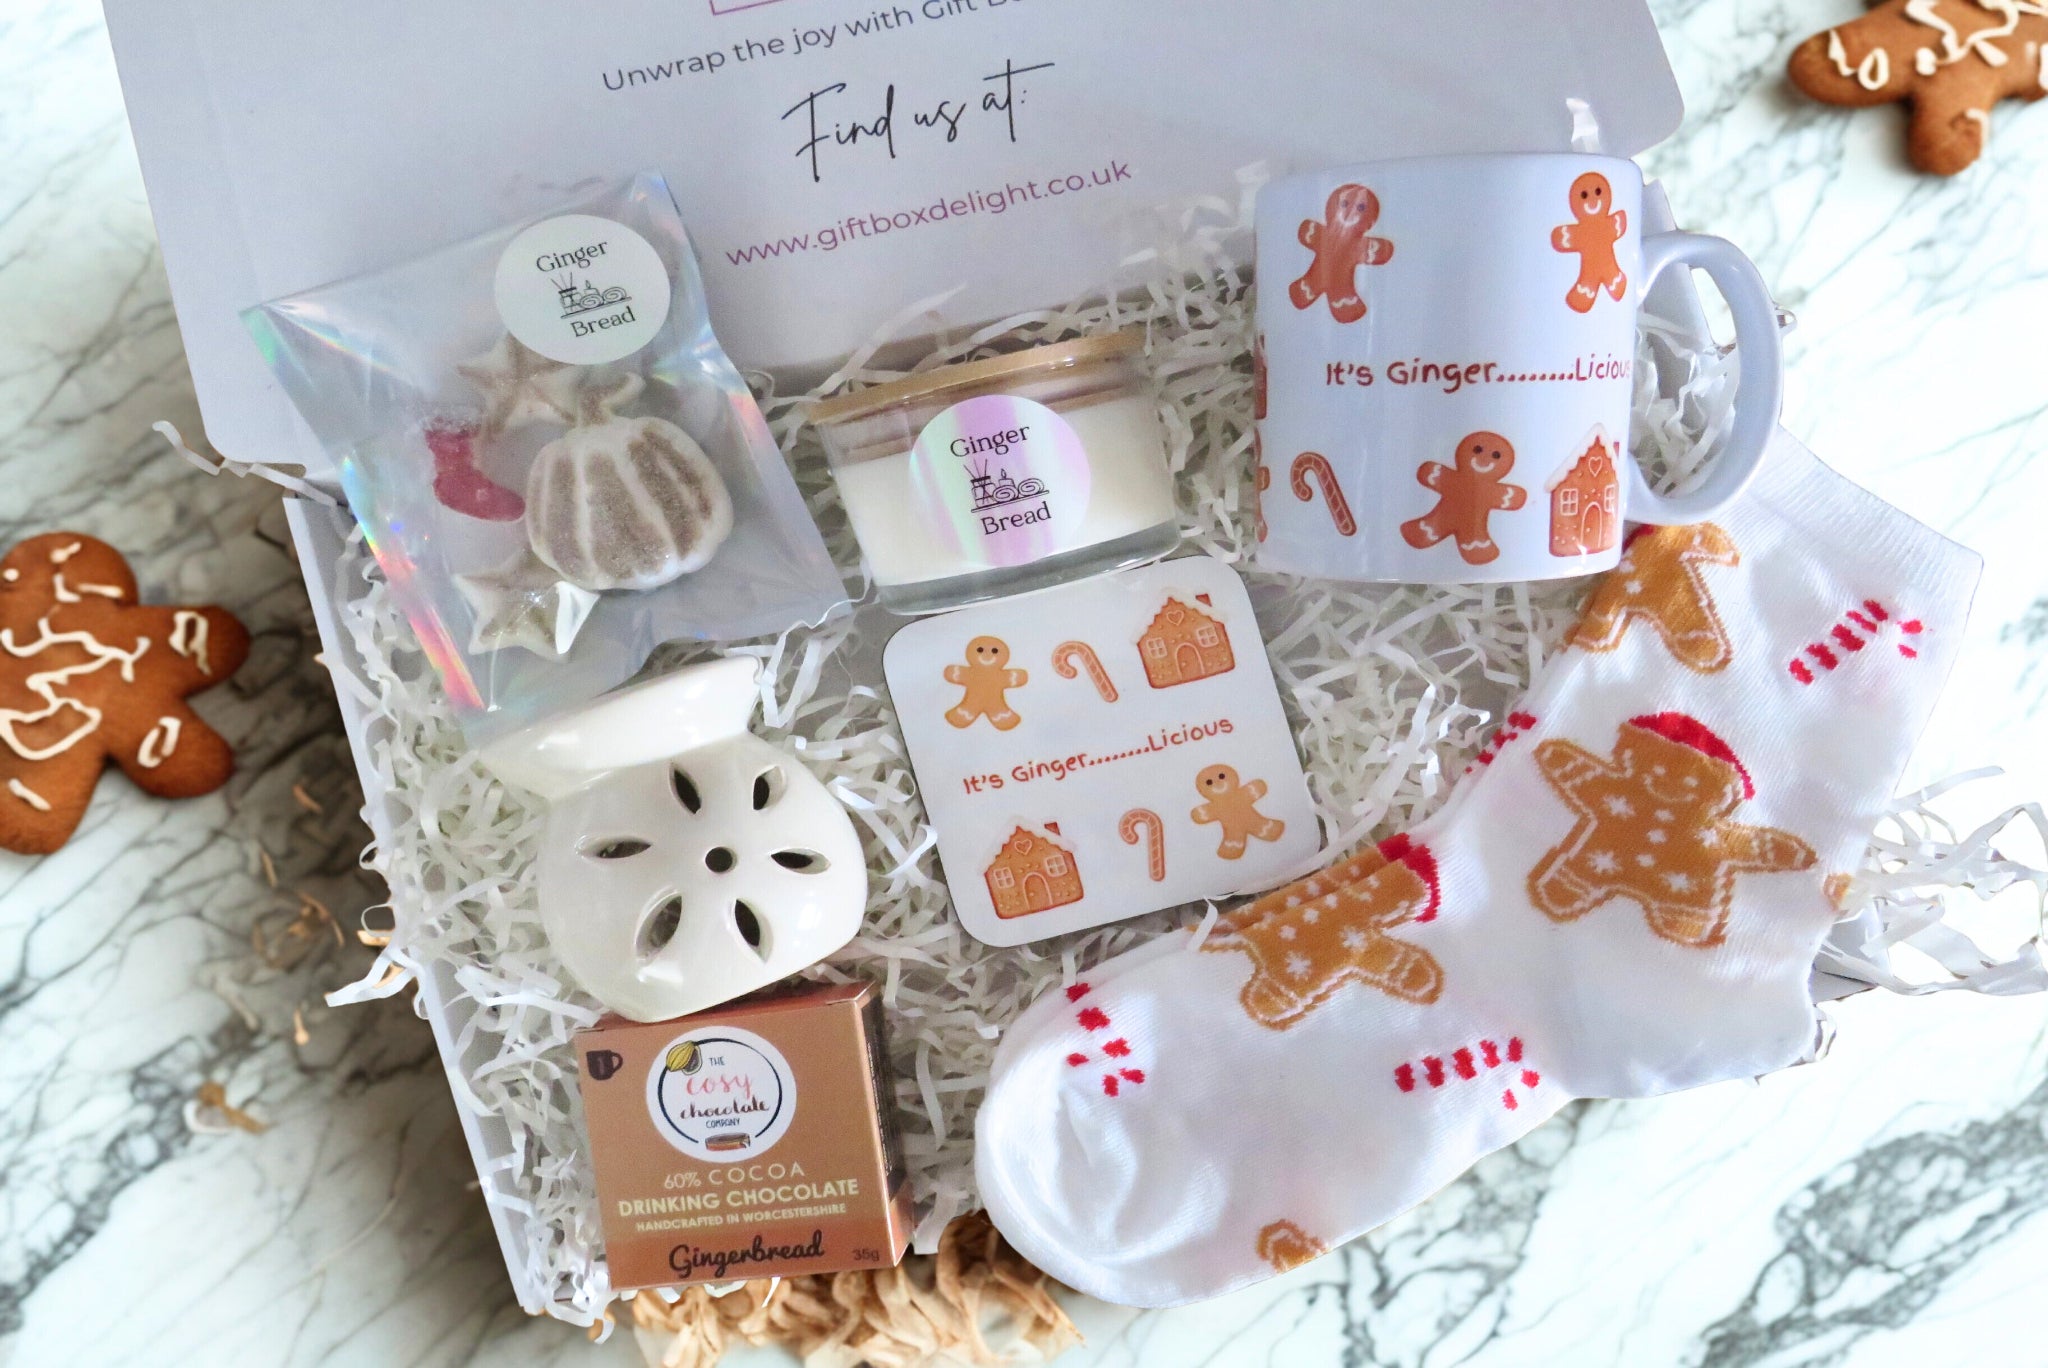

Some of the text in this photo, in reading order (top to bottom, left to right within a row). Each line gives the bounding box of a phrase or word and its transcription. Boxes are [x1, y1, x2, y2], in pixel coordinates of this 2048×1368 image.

[602, 50, 726, 91] Unwrap
[733, 38, 786, 62] the
[791, 22, 836, 55] joy
[845, 6, 914, 37] with
[781, 82, 896, 182] Find
[914, 101, 966, 142] us
[726, 159, 1132, 267] www.giftboxdelight.co.uk
[536, 241, 608, 273] Ginger
[570, 306, 636, 338] Bread
[1326, 361, 1374, 387] It's
[950, 426, 1030, 457] Ginger
[980, 501, 1052, 535] Bread
[963, 773, 1004, 794] It's
[709, 1056, 725, 1066] THE
[680, 1095, 770, 1119] chocolate
[664, 1161, 806, 1190] 60% COCOA
[617, 1178, 859, 1217] DRINKING CHOCOLATE
[636, 1203, 847, 1232] HANDCRAFTED IN WORCESTERSHIRE
[669, 1229, 825, 1279] Gingerbread
[853, 1248, 880, 1262] 35g
